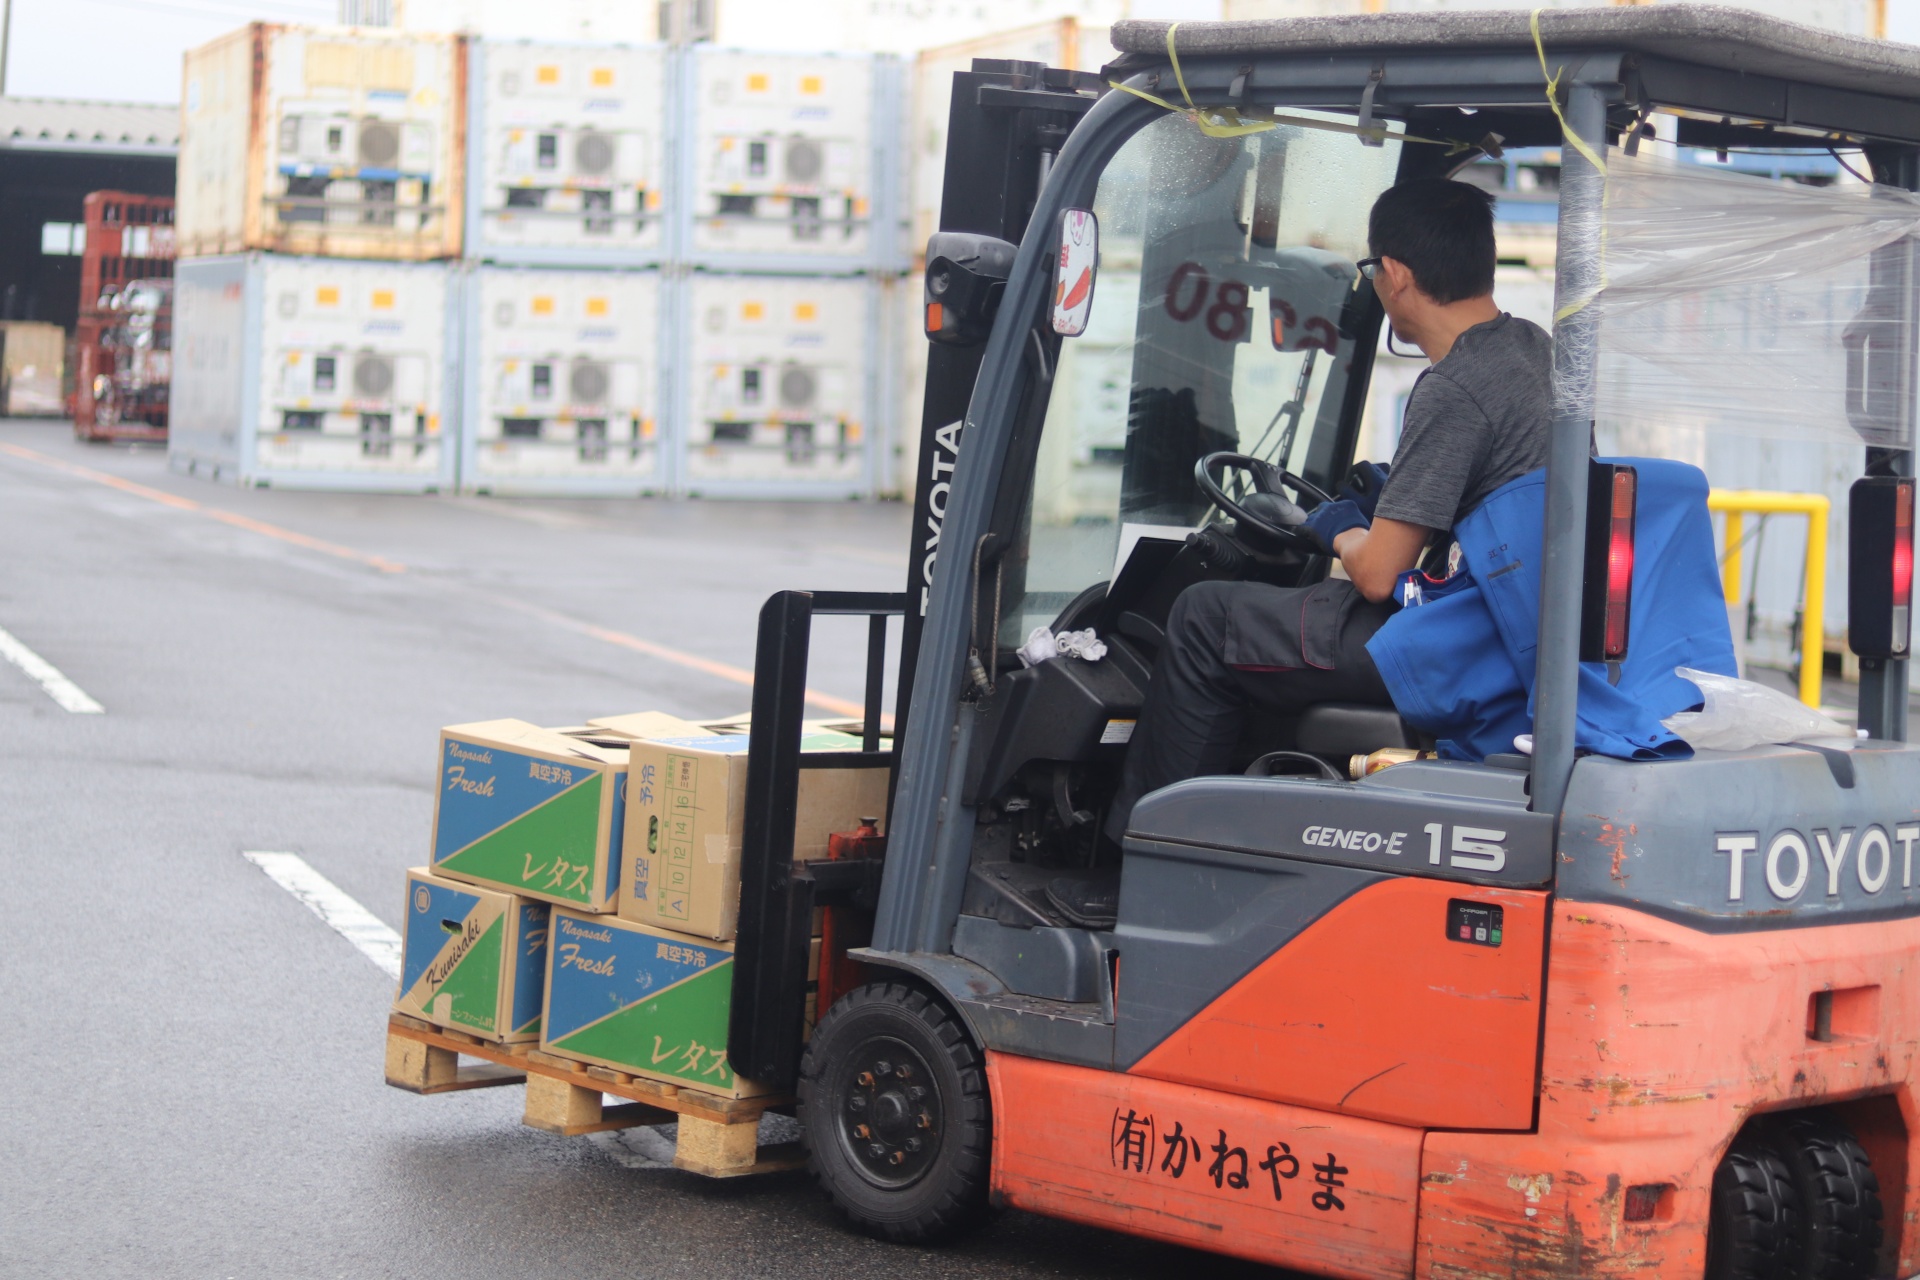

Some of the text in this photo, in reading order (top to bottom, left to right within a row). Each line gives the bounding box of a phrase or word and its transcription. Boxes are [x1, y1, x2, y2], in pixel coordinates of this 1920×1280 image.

[448, 742, 493, 764] Nagasaki
[447, 766, 497, 798] Fresh
[528, 762, 573, 786] 真空予冷
[633, 764, 655, 901] 真空 予冷
[675, 821, 687, 835] 14
[673, 847, 686, 861] 12
[1301, 822, 1507, 872] GENEO-E 15
[521, 852, 590, 895] レタス
[671, 872, 685, 885] 10
[1717, 826, 1920, 901] TOYOT
[560, 919, 613, 944] Nagasaki
[426, 918, 481, 992] Kunisaki
[559, 943, 617, 977] Fresh
[655, 942, 707, 968] 真空予冷
[650, 1035, 728, 1081] レタス
